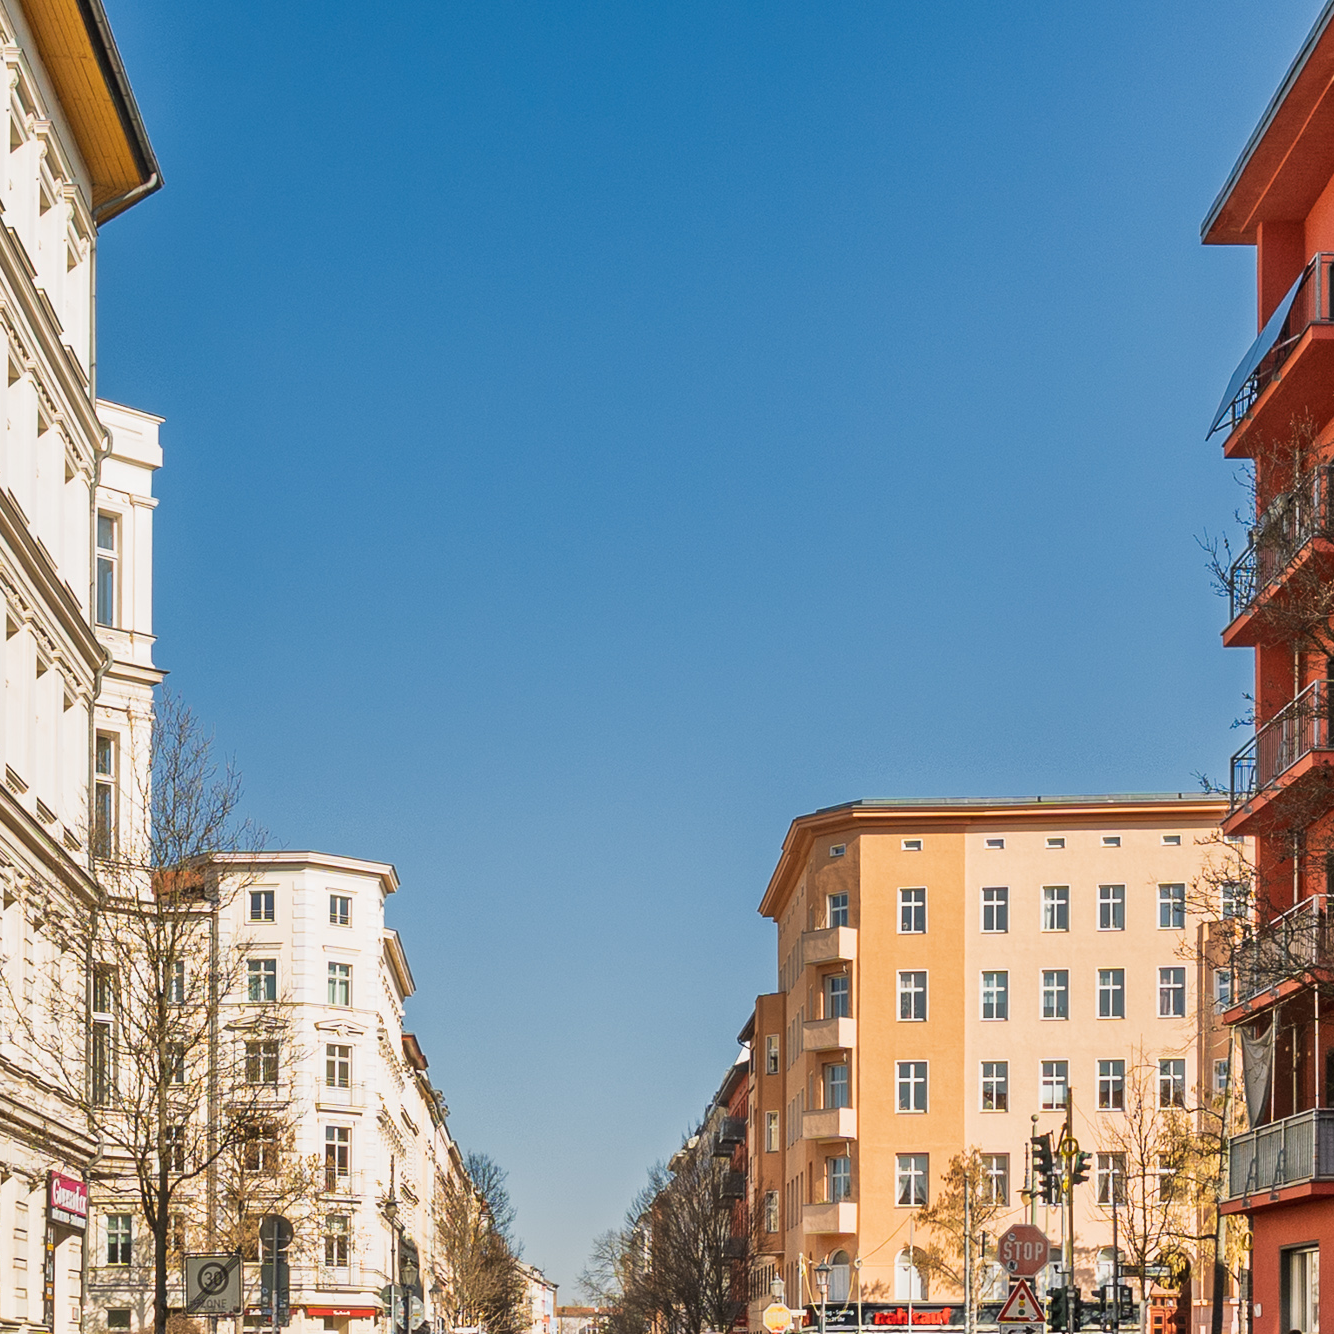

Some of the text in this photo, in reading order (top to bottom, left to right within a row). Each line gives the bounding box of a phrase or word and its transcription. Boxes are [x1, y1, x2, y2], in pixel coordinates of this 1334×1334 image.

[1003, 1241, 1044, 1261] STOP
[204, 1271, 223, 1287] 30
[874, 1307, 952, 1325] nahkauf
